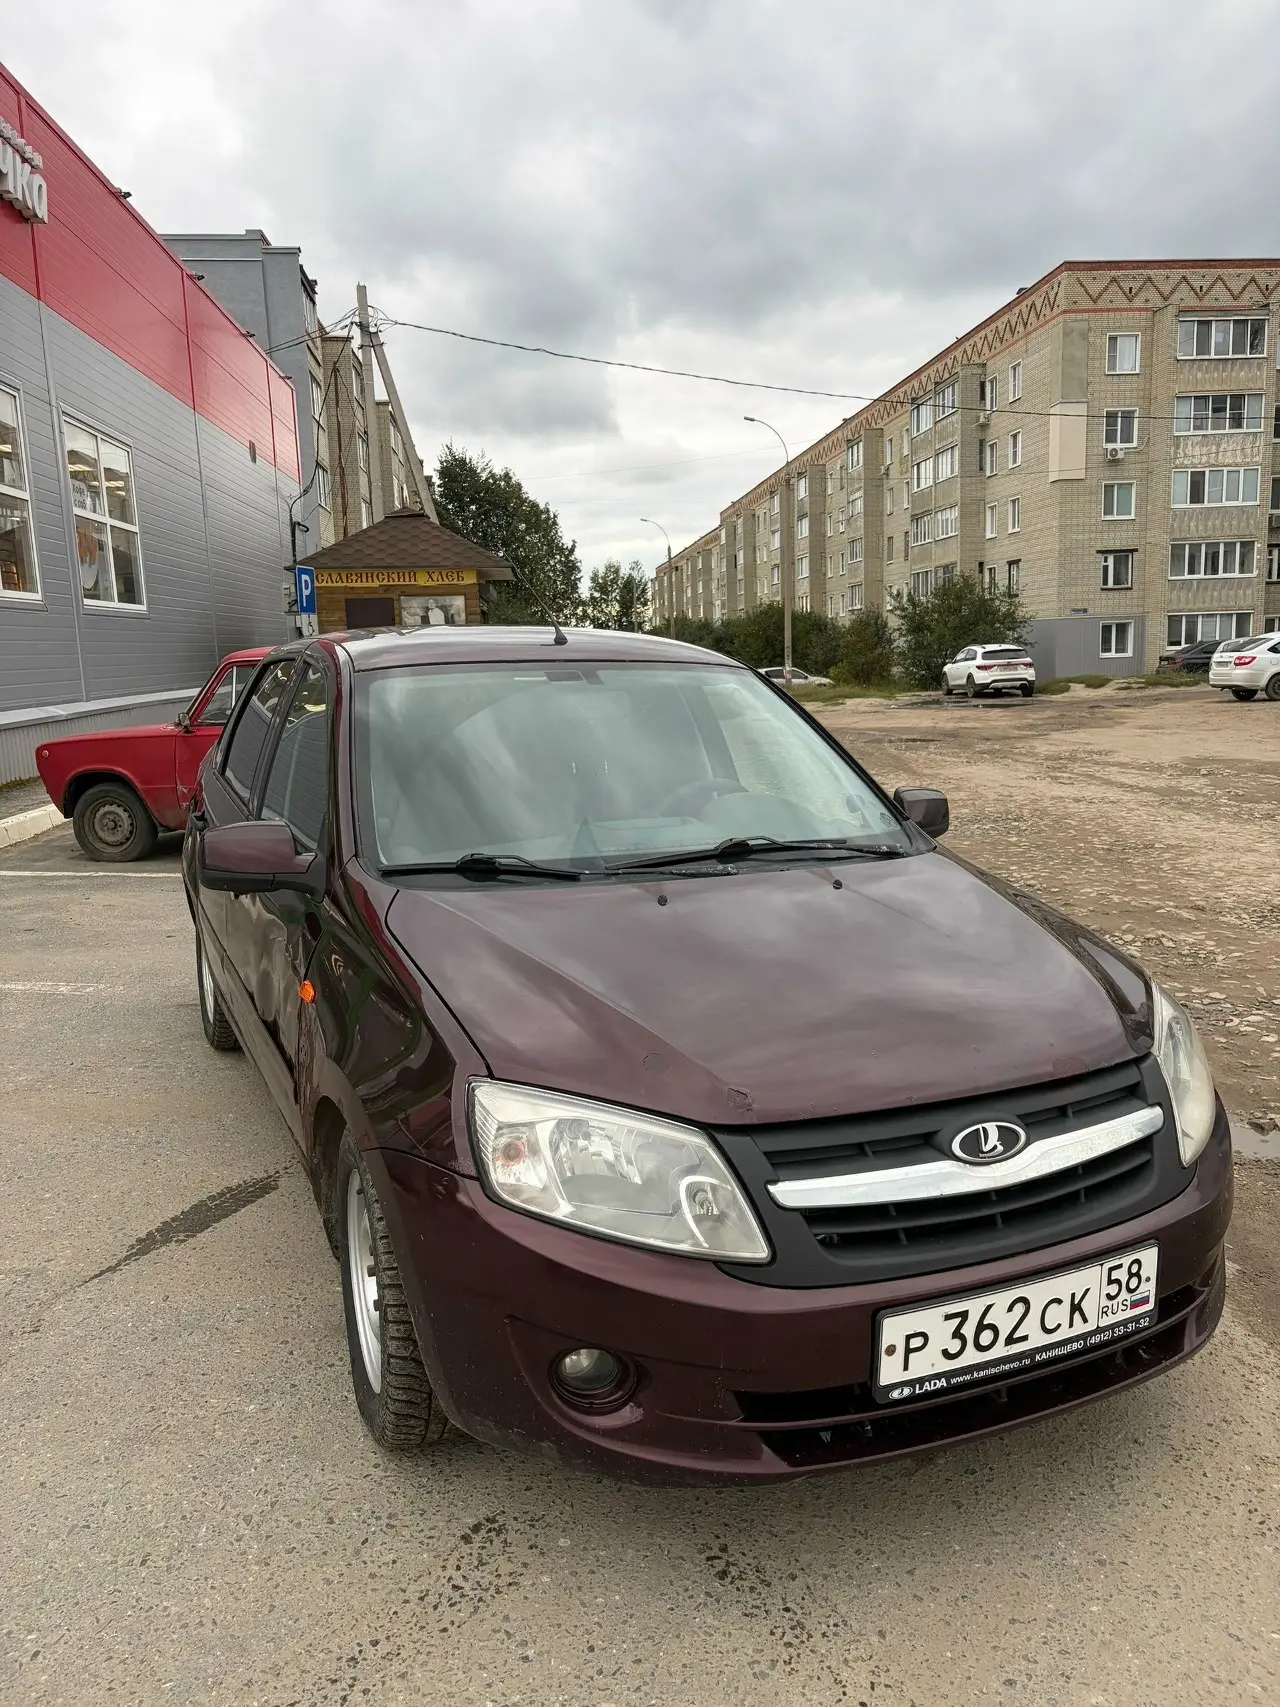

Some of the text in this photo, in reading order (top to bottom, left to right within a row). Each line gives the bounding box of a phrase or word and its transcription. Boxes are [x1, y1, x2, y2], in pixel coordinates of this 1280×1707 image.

[301, 574, 311, 607] P
[315, 570, 465, 584] СЛАВЯНСКИЙ ХЛЕБ
[1105, 1258, 1142, 1301] 58
[1101, 1299, 1129, 1319] RUS
[915, 1317, 1150, 1394] LADA www.kanischevo.ru КАНИЩЕВО (4912) 33-31-32
